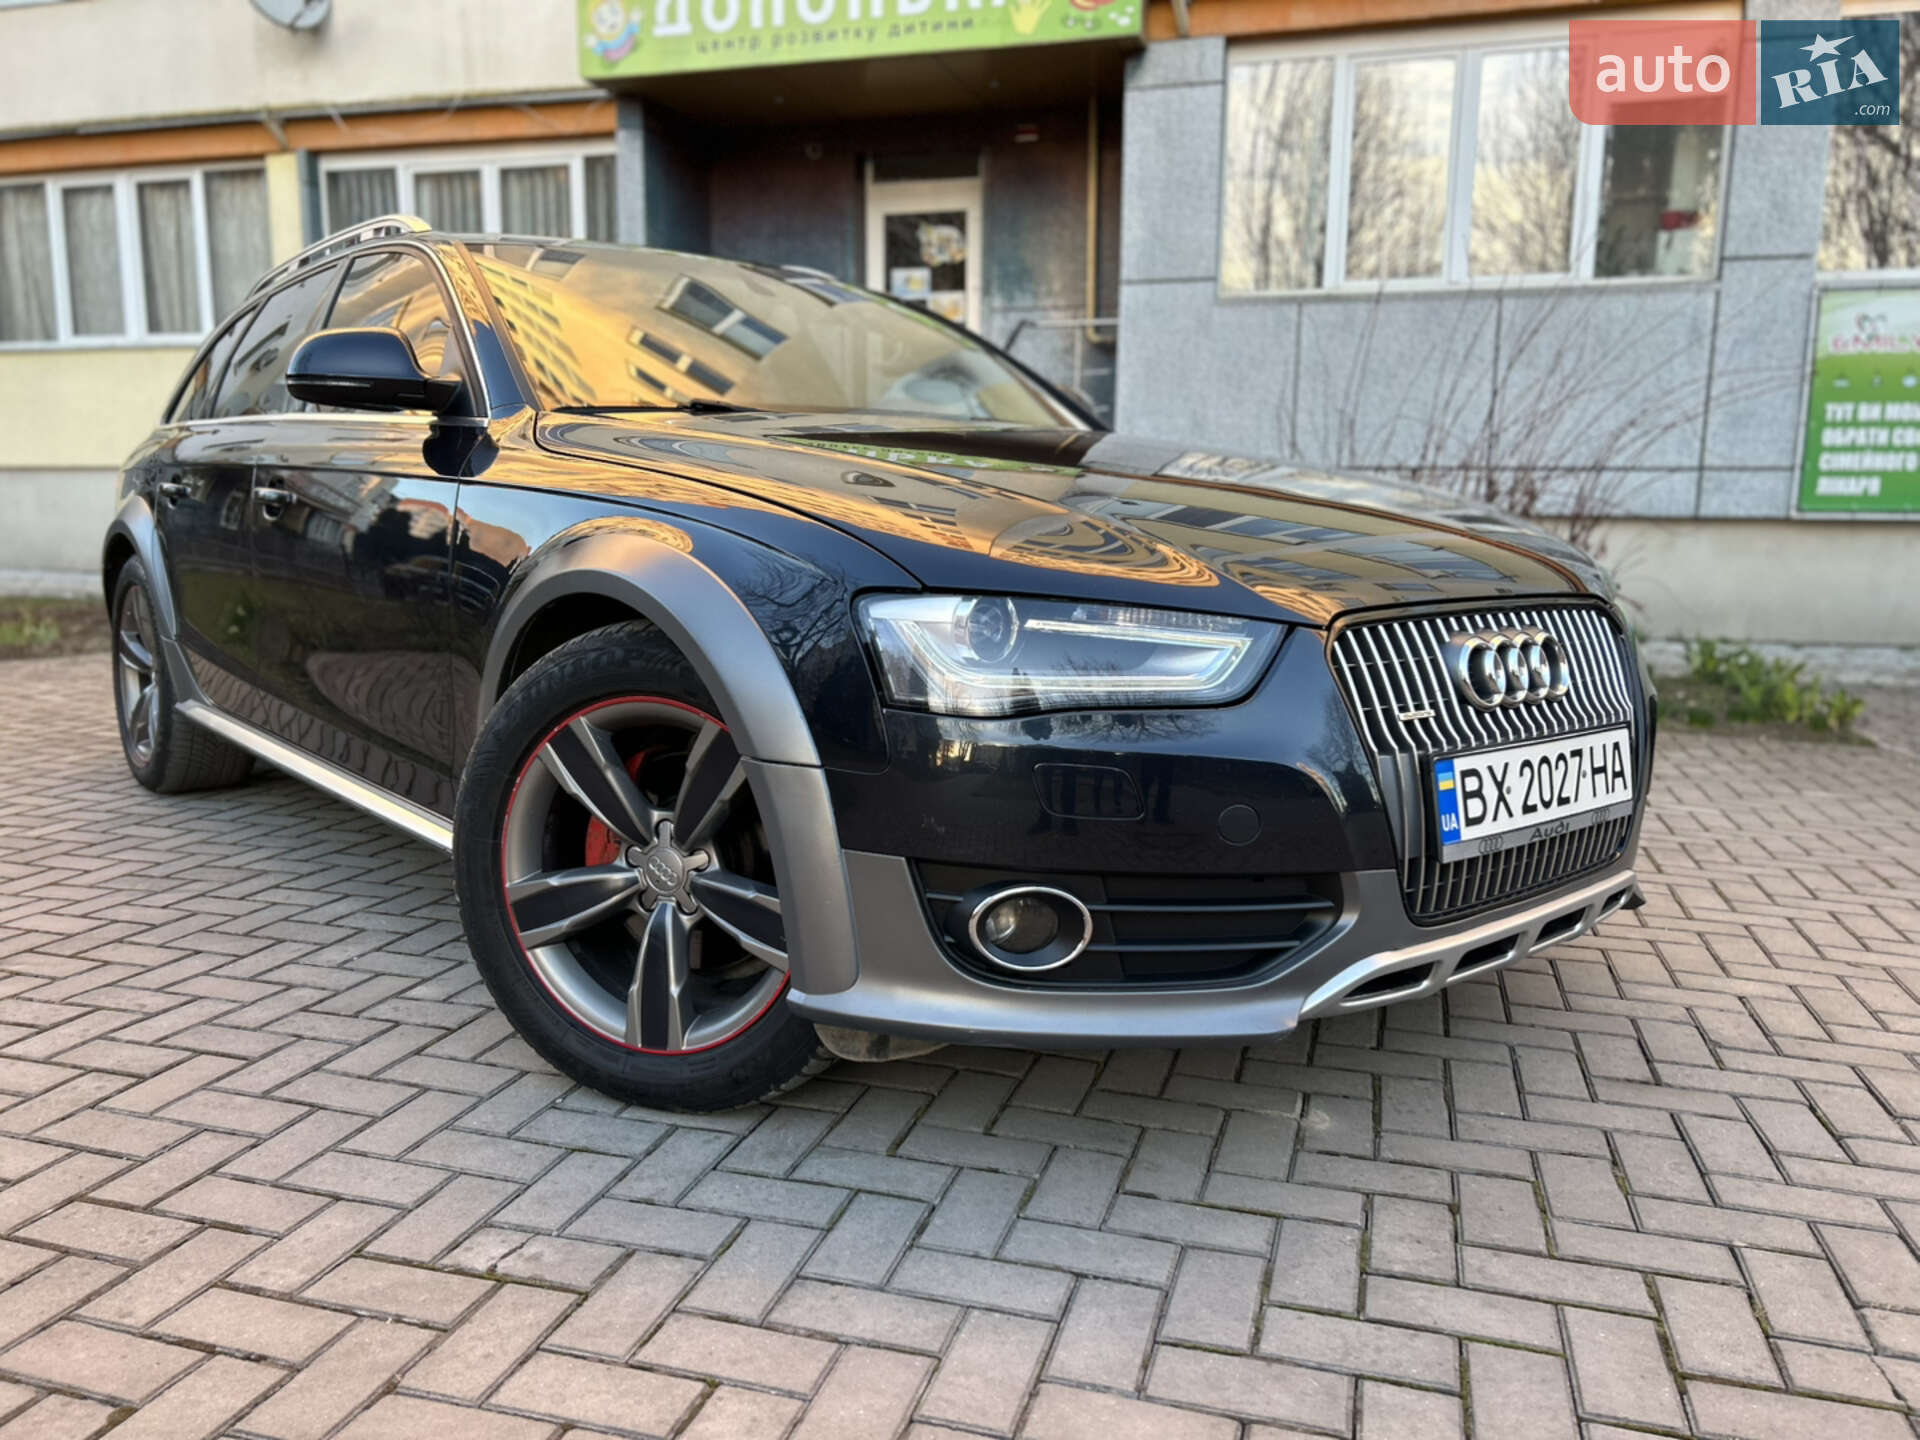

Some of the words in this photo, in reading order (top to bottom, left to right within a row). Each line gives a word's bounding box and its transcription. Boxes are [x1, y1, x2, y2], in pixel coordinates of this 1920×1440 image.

[1460, 762, 1514, 827] BX
[1519, 748, 1583, 815] 2027
[1589, 740, 1627, 798] HA
[1441, 813, 1459, 832] UA
[1529, 821, 1570, 841] Audi
